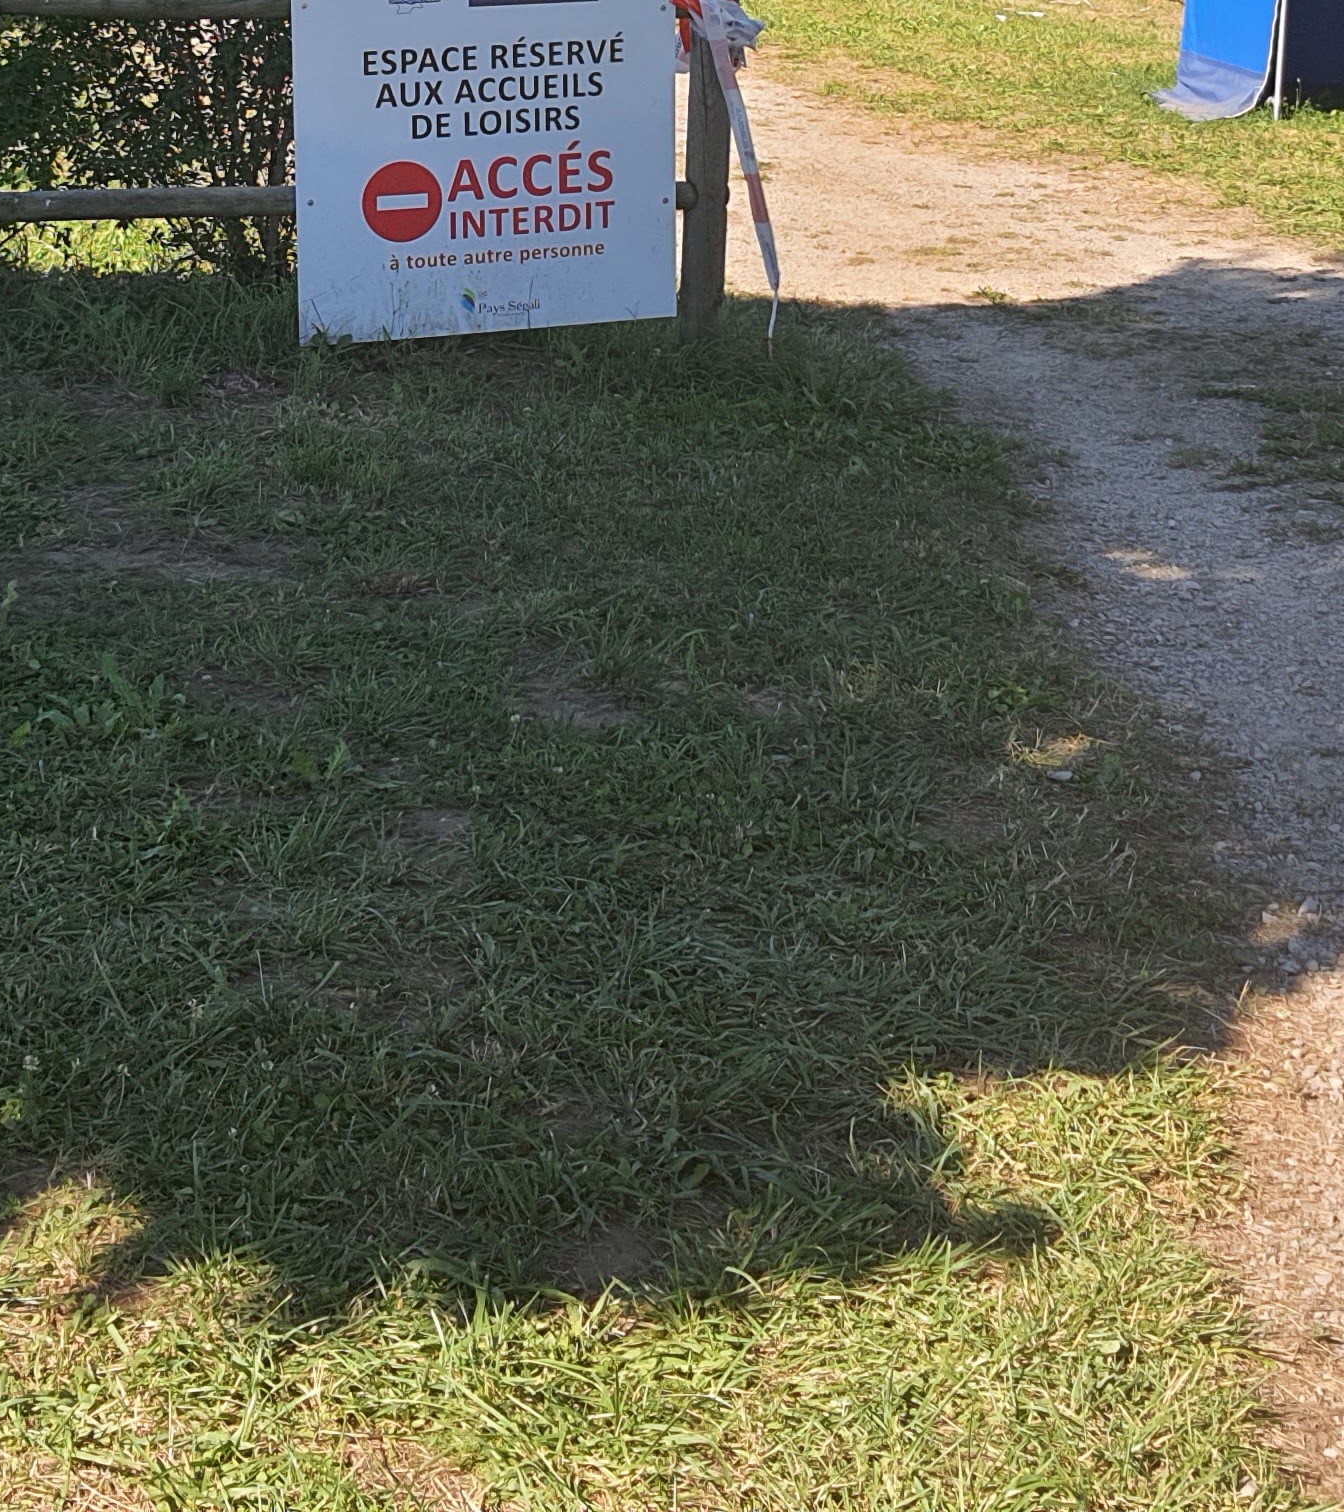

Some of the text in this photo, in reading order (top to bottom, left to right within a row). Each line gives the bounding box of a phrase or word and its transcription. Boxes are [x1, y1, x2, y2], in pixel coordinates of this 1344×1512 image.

[363, 31, 624, 76] ESPACE RÉSERVÉ
[376, 72, 603, 108] AUX ACCUEILS
[412, 105, 580, 139] DE LOISIRS
[447, 140, 613, 202] ACCÉS
[450, 201, 615, 239] INTERDIT
[389, 243, 605, 270] à toute autre personne
[478, 302, 505, 315] Pays
